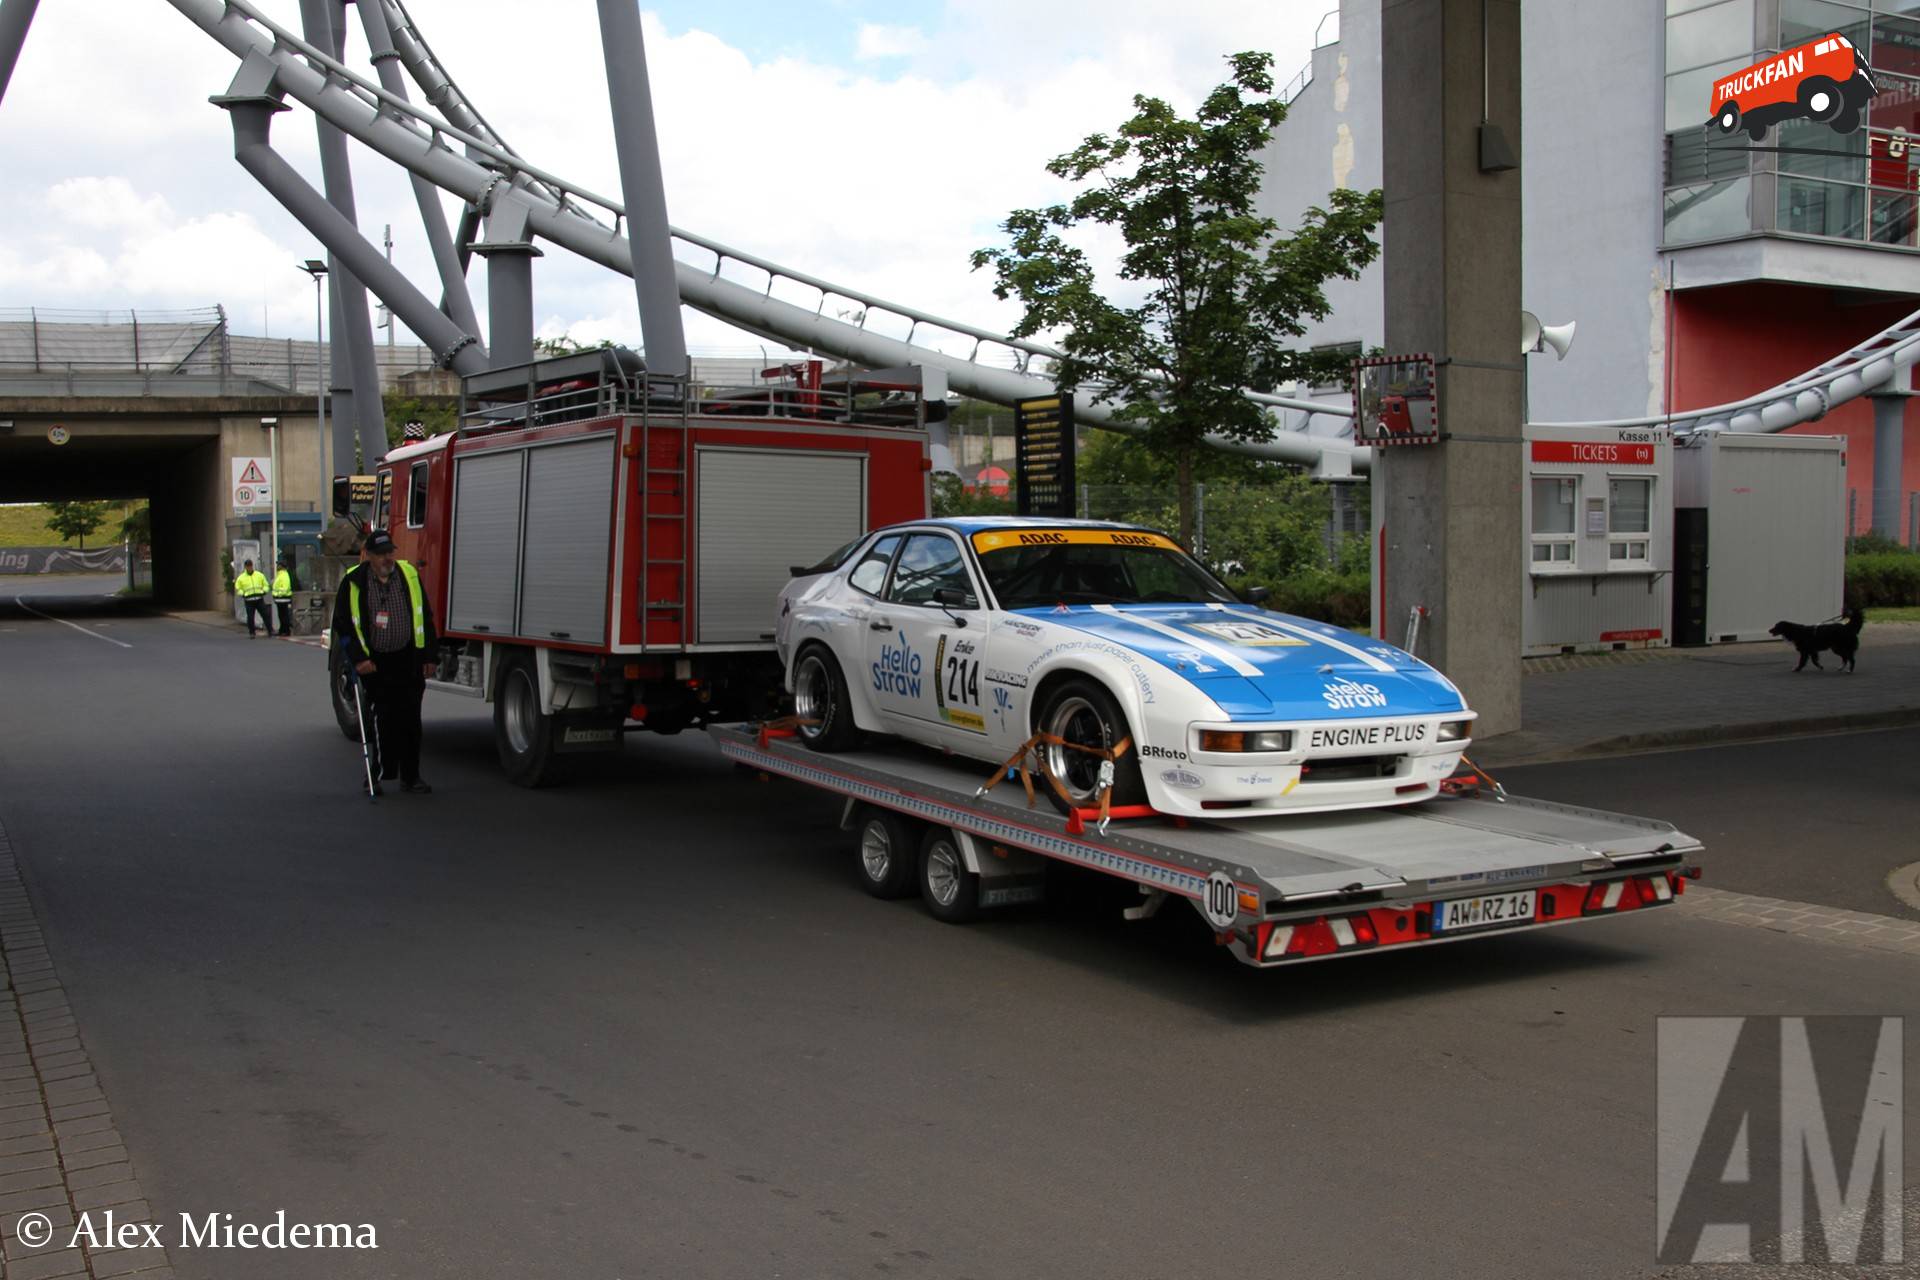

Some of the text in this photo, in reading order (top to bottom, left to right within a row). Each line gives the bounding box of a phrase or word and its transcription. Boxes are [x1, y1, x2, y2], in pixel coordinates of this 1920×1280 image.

[1618, 431, 1662, 442] Kasse 11
[1571, 444, 1618, 461] TICKETS
[239, 490, 250, 500] 10
[1019, 533, 1156, 546] ADAC ADAC
[881, 643, 921, 675] Hello
[872, 662, 921, 698] Straw
[948, 656, 979, 706] 214
[1027, 640, 1155, 704] more than just paper cutlery
[1323, 681, 1380, 696] Hello
[1322, 691, 1387, 710] Straw
[1311, 724, 1426, 747] ENGINE PLUS
[1142, 745, 1187, 760] BRfoto
[1207, 878, 1236, 918] 100
[1449, 904, 1473, 926] AW
[1482, 898, 1503, 921] RZ
[1508, 895, 1529, 917] 16
